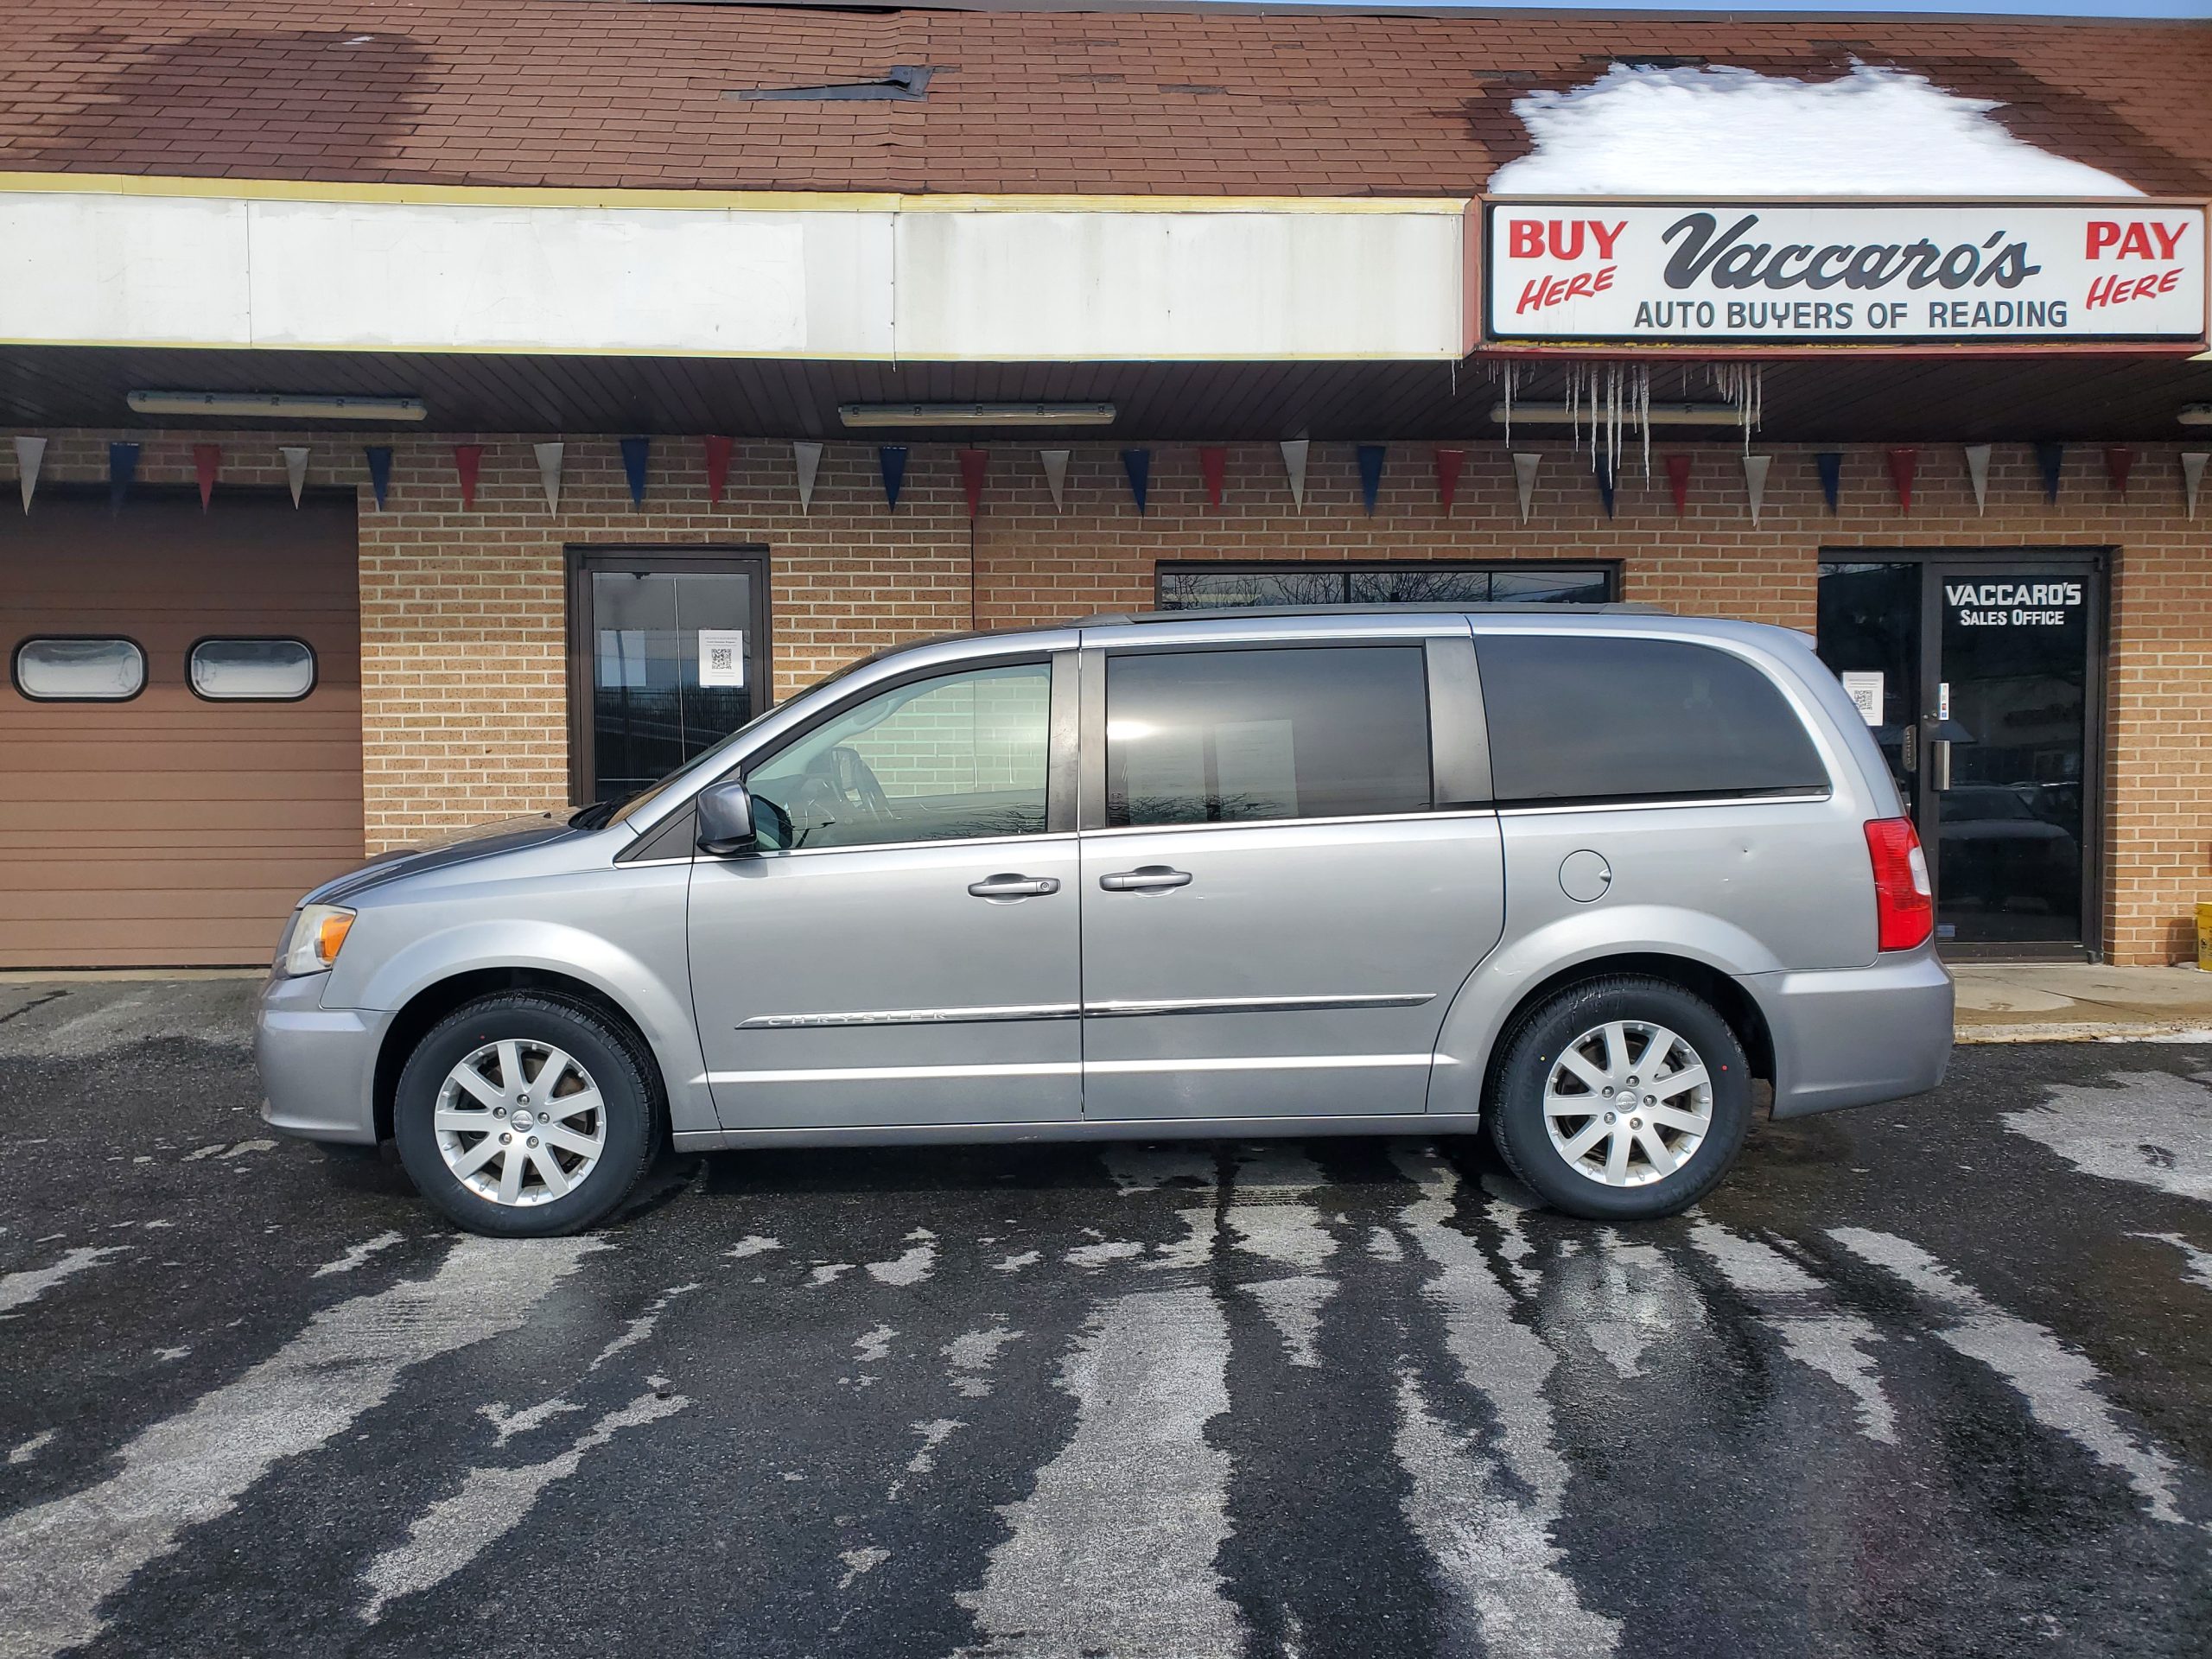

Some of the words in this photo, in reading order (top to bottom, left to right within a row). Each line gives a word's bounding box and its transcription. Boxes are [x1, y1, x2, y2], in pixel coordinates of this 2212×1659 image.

[1509, 219, 1629, 260] BUY
[1662, 212, 2042, 290] Vaccaro's
[2085, 221, 2189, 260] PAY
[1516, 265, 1618, 315] HERE
[2085, 267, 2185, 311] HERE
[1633, 301, 1716, 328] AUTO
[1726, 301, 1854, 329] BUYERS
[1866, 302, 1908, 329] OF
[1929, 301, 2068, 328] READING
[1945, 582, 2082, 606] VACCARO'S
[767, 1012, 948, 1026] CHRYSLER
